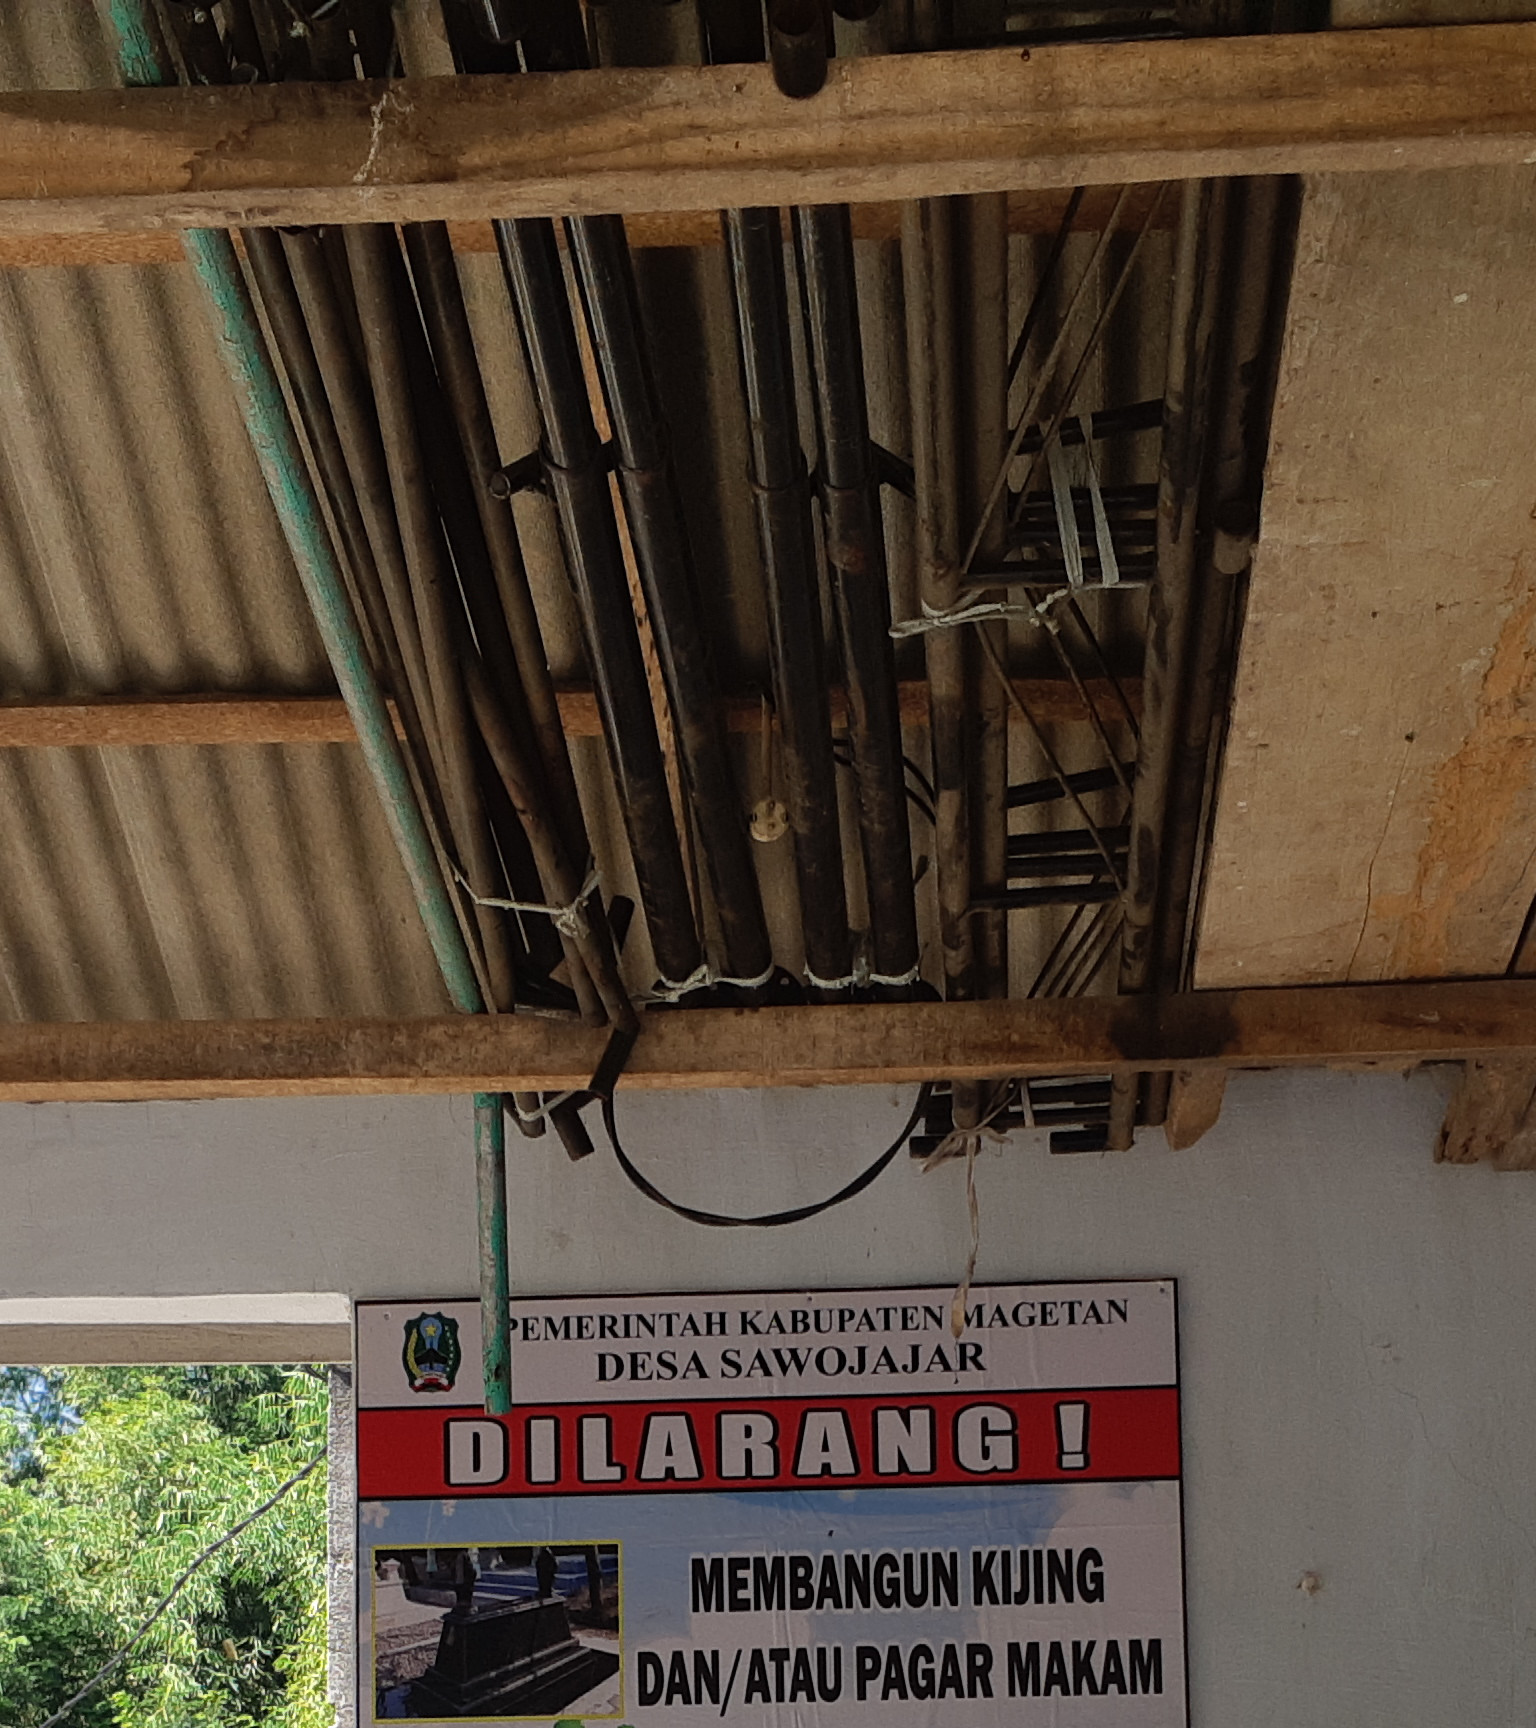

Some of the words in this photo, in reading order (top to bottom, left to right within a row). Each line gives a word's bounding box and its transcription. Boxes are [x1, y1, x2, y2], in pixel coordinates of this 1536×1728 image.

[739, 1305, 944, 1335] KABUPATEN
[963, 1299, 1128, 1329] MAGETAN
[596, 1350, 710, 1382] DESA
[720, 1341, 987, 1379] SAWOJAJAR
[444, 1402, 1019, 1487] DILARANG
[1055, 1401, 1090, 1471] !
[691, 1551, 959, 1613] MEMBANGUN
[972, 1547, 1105, 1606] KIJING
[637, 1646, 842, 1717] DAN/ATAU
[855, 1643, 994, 1701] PAGAR
[1007, 1638, 1163, 1698] MAKAM
